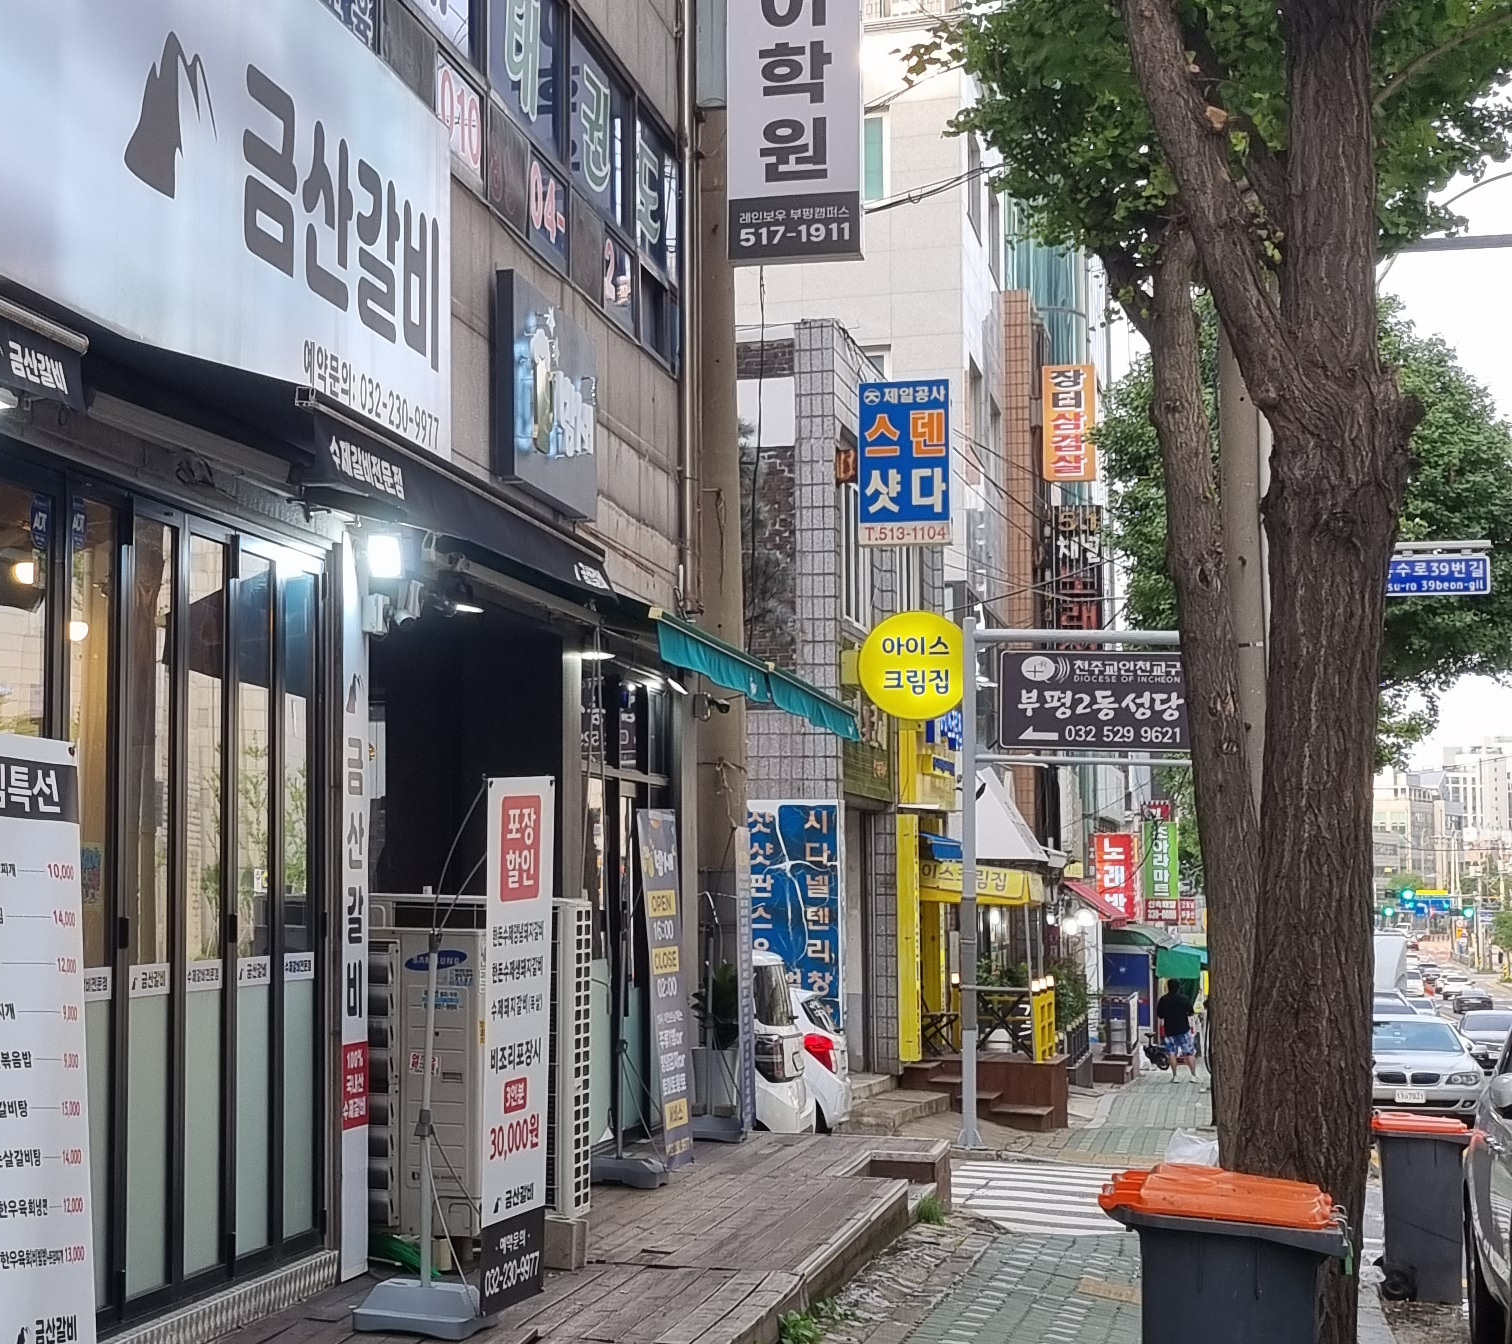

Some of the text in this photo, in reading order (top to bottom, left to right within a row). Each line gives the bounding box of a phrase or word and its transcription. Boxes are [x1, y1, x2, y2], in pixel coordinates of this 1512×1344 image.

[242, 61, 440, 373] 금산갈비
[739, 204, 851, 225] 레인보우 부평캠퍼스
[739, 223, 851, 246] 517-1911
[7, 339, 69, 396] 금산갈비
[303, 339, 440, 450] 예약문의: 032-230-9977
[883, 385, 947, 403] 제일공사
[1049, 368, 1088, 477] 장터삼겹살
[329, 435, 406, 499] 수제갈비전문점
[864, 467, 947, 514] 샷다
[864, 525, 948, 542] T.513-1104
[1420, 578, 1484, 592] 39beon-gil
[882, 636, 950, 657] 아이스
[1073, 674, 1182, 684] DIOCESE OF INCHEON
[1074, 660, 1182, 678] 천주교인천교구
[882, 669, 950, 695] 크림집
[1017, 690, 1185, 721] 부평2동성당
[1065, 726, 1181, 743] 032 529 9621
[506, 807, 537, 846] 포장
[47, 862, 75, 881] 10,000
[346, 736, 366, 1019] 금산갈비
[505, 849, 535, 889] 할인
[650, 894, 672, 912] OPEN
[52, 909, 76, 929] 14,000
[56, 958, 77, 975] 12,000
[412, 955, 460, 966] SAUNG
[62, 1005, 79, 1022] 9,000
[63, 1053, 80, 1069] 9,000
[490, 1036, 542, 1075] 비조리포장시
[60, 1100, 81, 1118] 15,000
[489, 1112, 540, 1162] 30,000원
[61, 1148, 82, 1166] 14,000
[63, 1196, 84, 1215] 12,000
[505, 1182, 534, 1210] 금산갈비
[64, 1245, 85, 1265] 13,000
[484, 1249, 540, 1299] 032-230-9977
